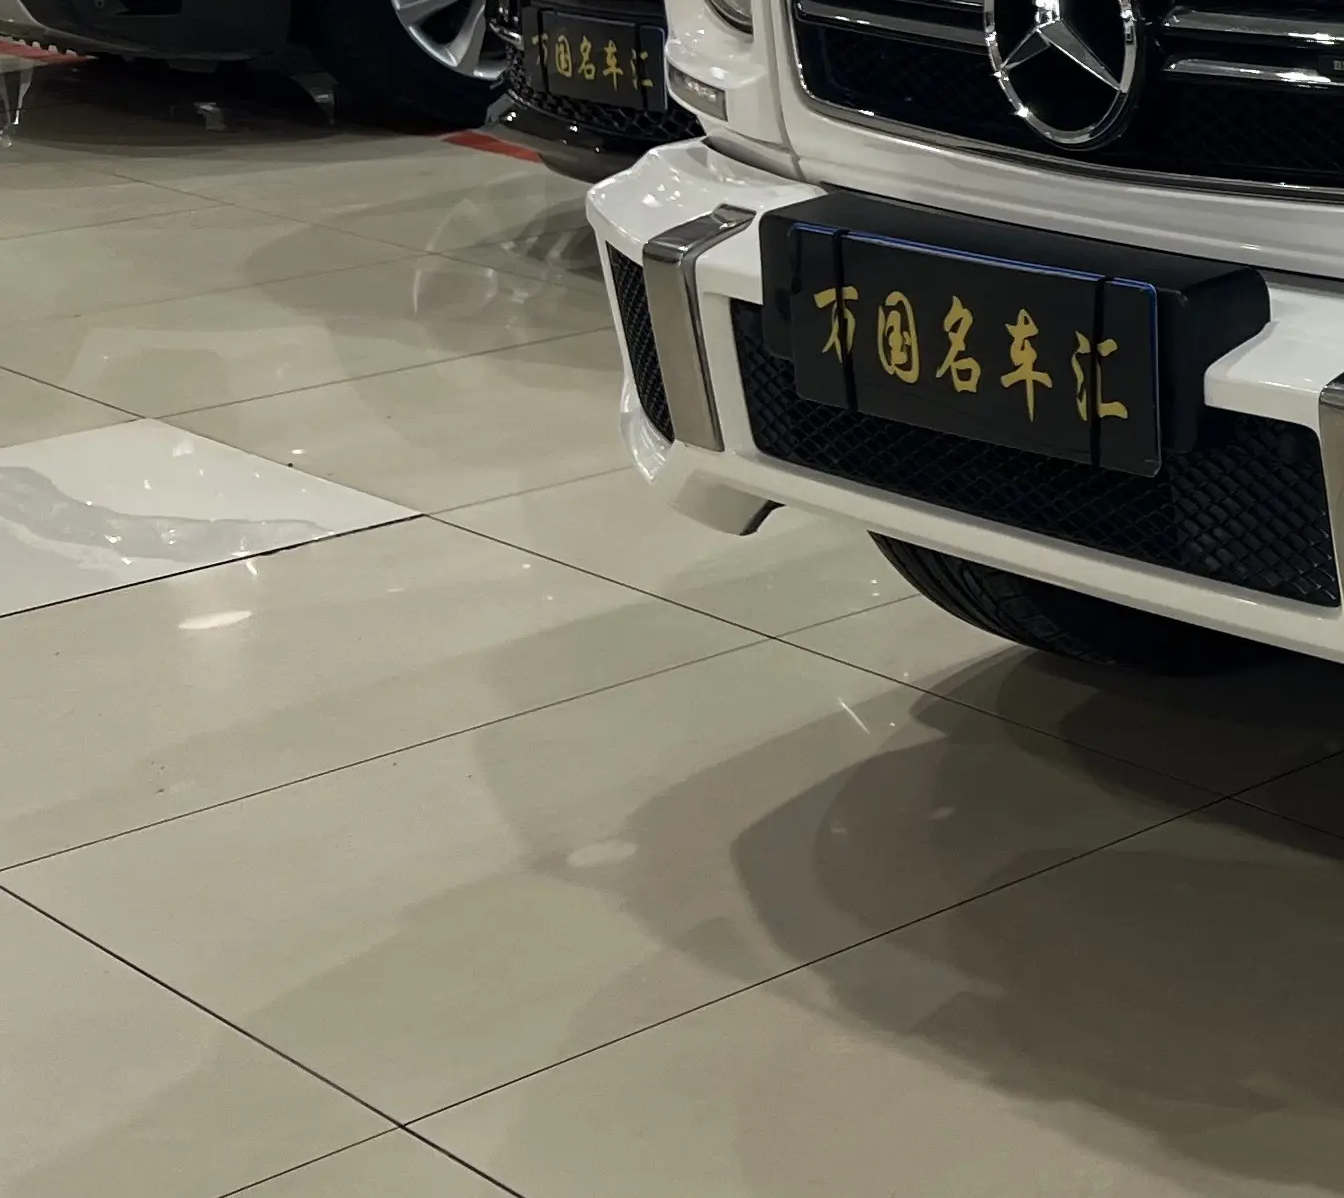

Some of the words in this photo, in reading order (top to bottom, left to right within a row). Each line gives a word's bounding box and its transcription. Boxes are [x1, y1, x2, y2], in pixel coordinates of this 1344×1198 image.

[813, 285, 1128, 423] 万国名车汇
